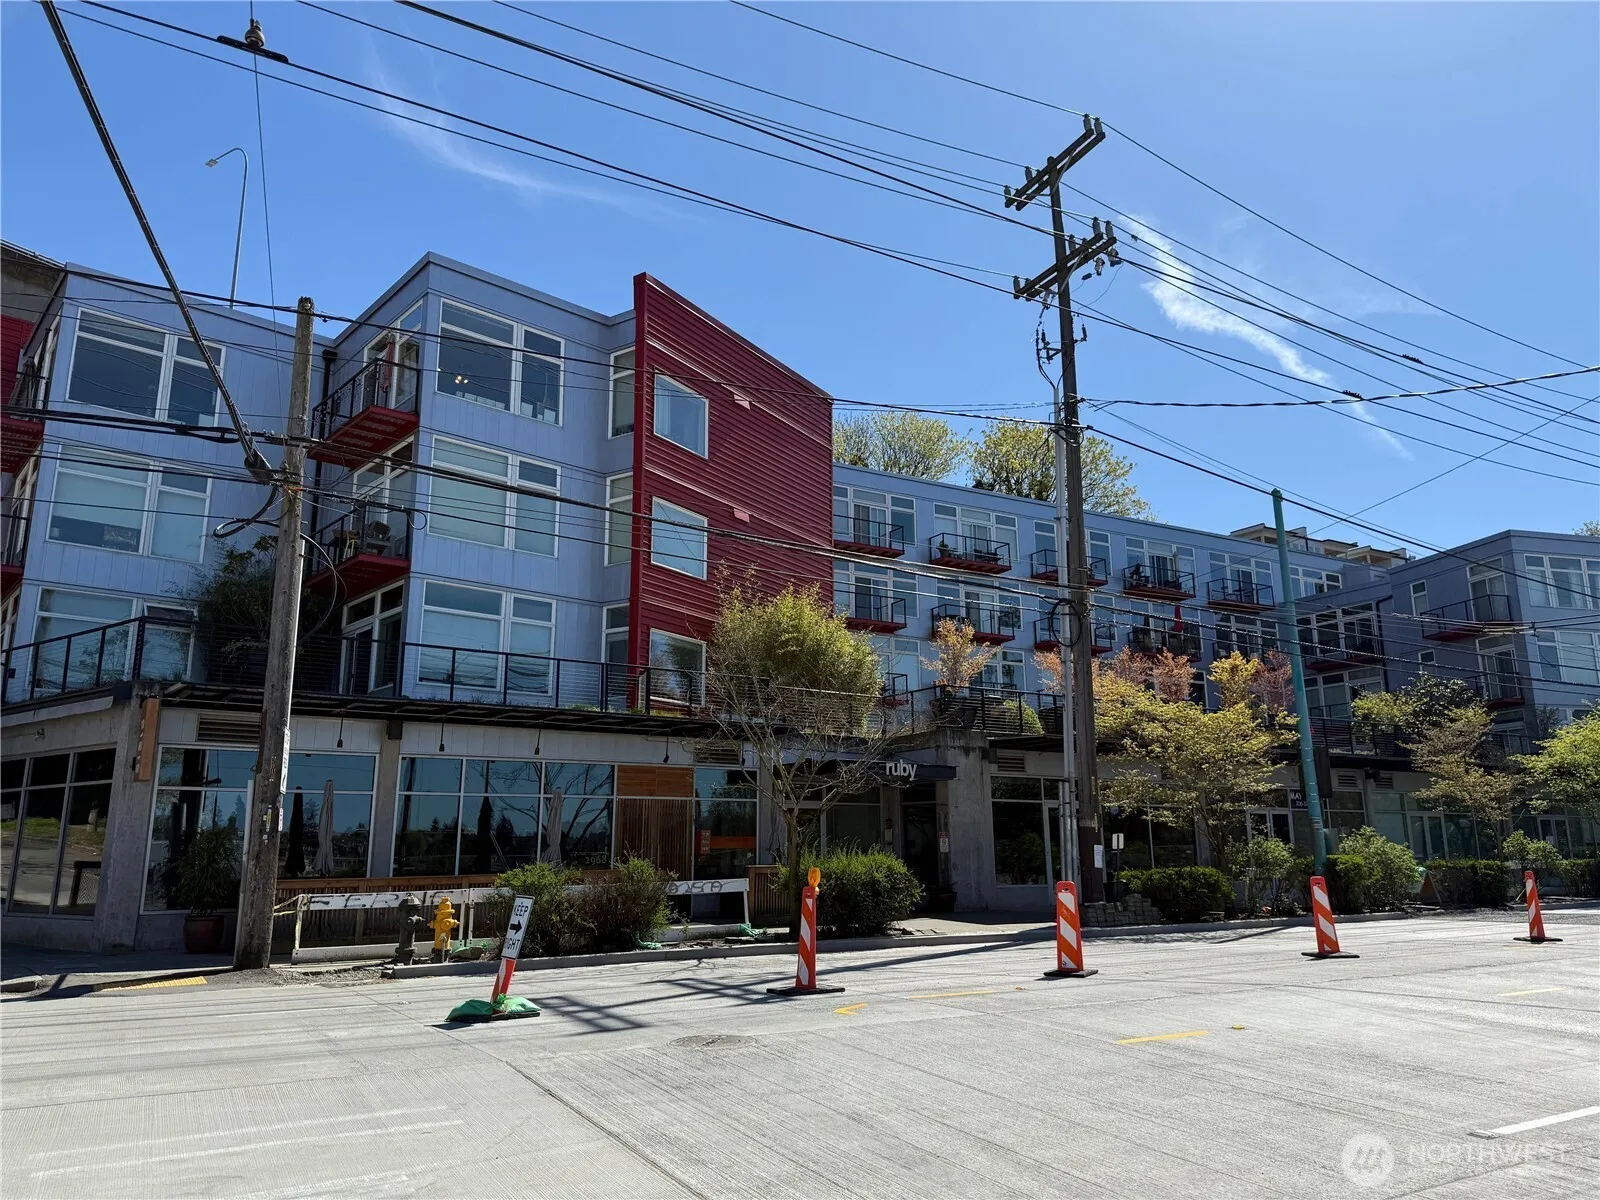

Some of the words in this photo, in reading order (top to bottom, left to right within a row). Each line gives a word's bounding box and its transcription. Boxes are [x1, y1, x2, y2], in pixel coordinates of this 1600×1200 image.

[886, 759, 917, 781] ruby
[584, 854, 607, 866] 2968
[513, 904, 529, 917] KEEP
